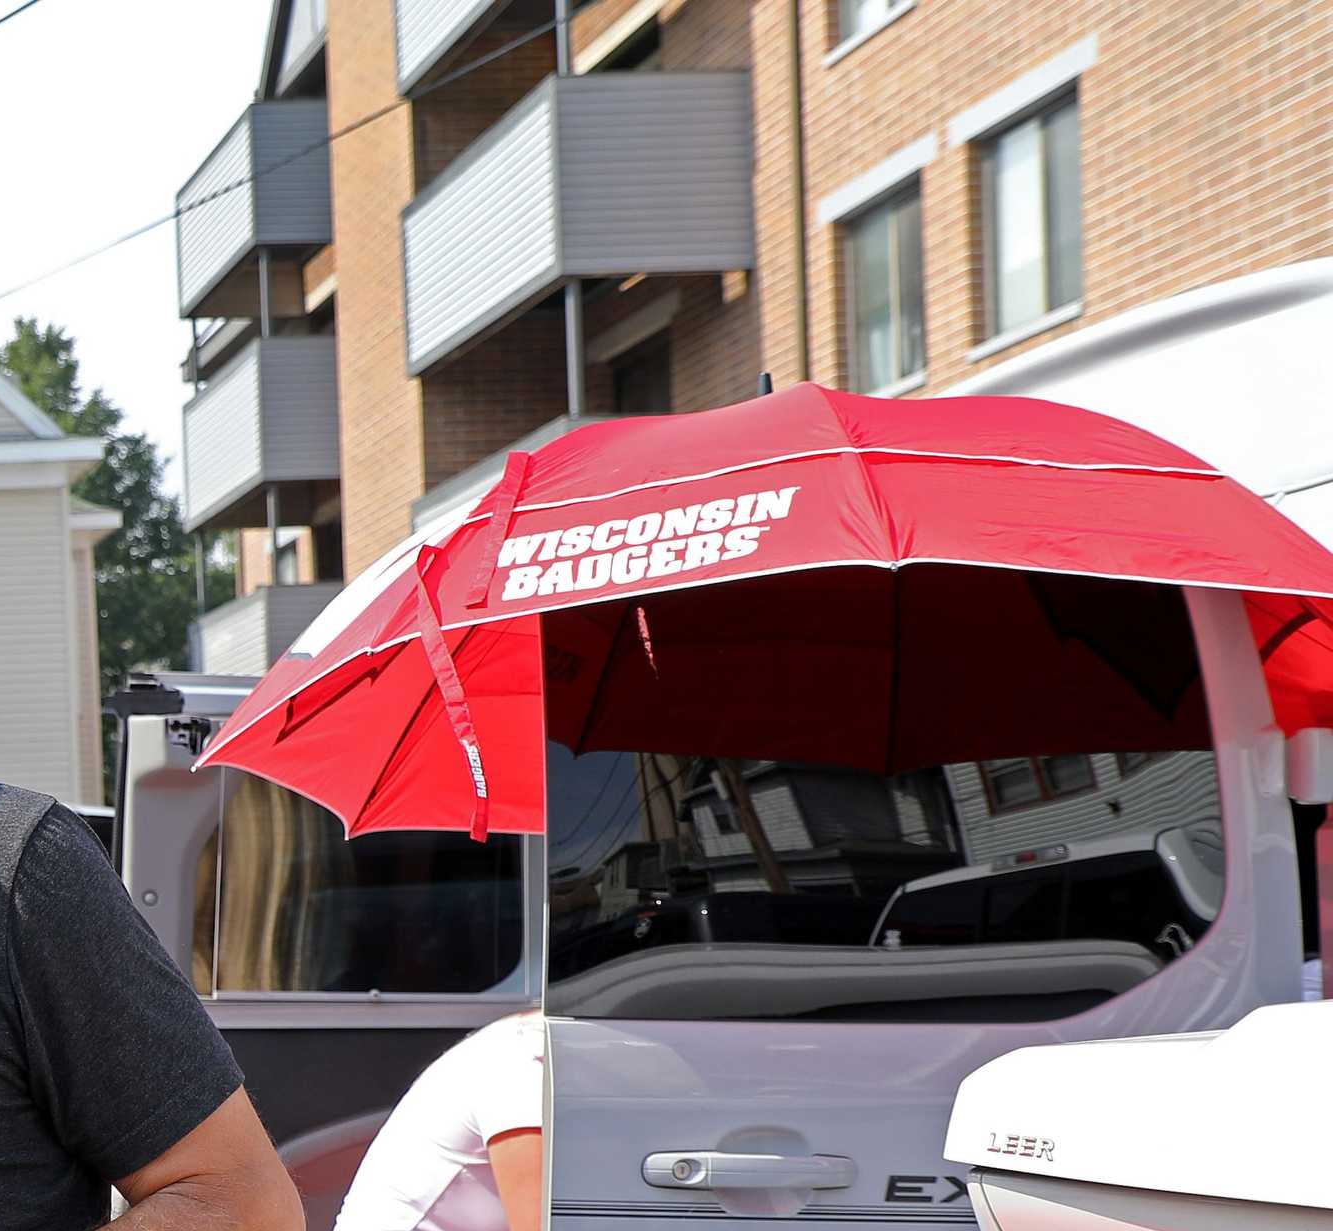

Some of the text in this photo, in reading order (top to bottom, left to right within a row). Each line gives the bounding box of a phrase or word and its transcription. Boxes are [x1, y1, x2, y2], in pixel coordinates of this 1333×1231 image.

[496, 486, 797, 568] WISCONSIN
[501, 525, 764, 602] BADGERS
[986, 1131, 1056, 1162] LEER
